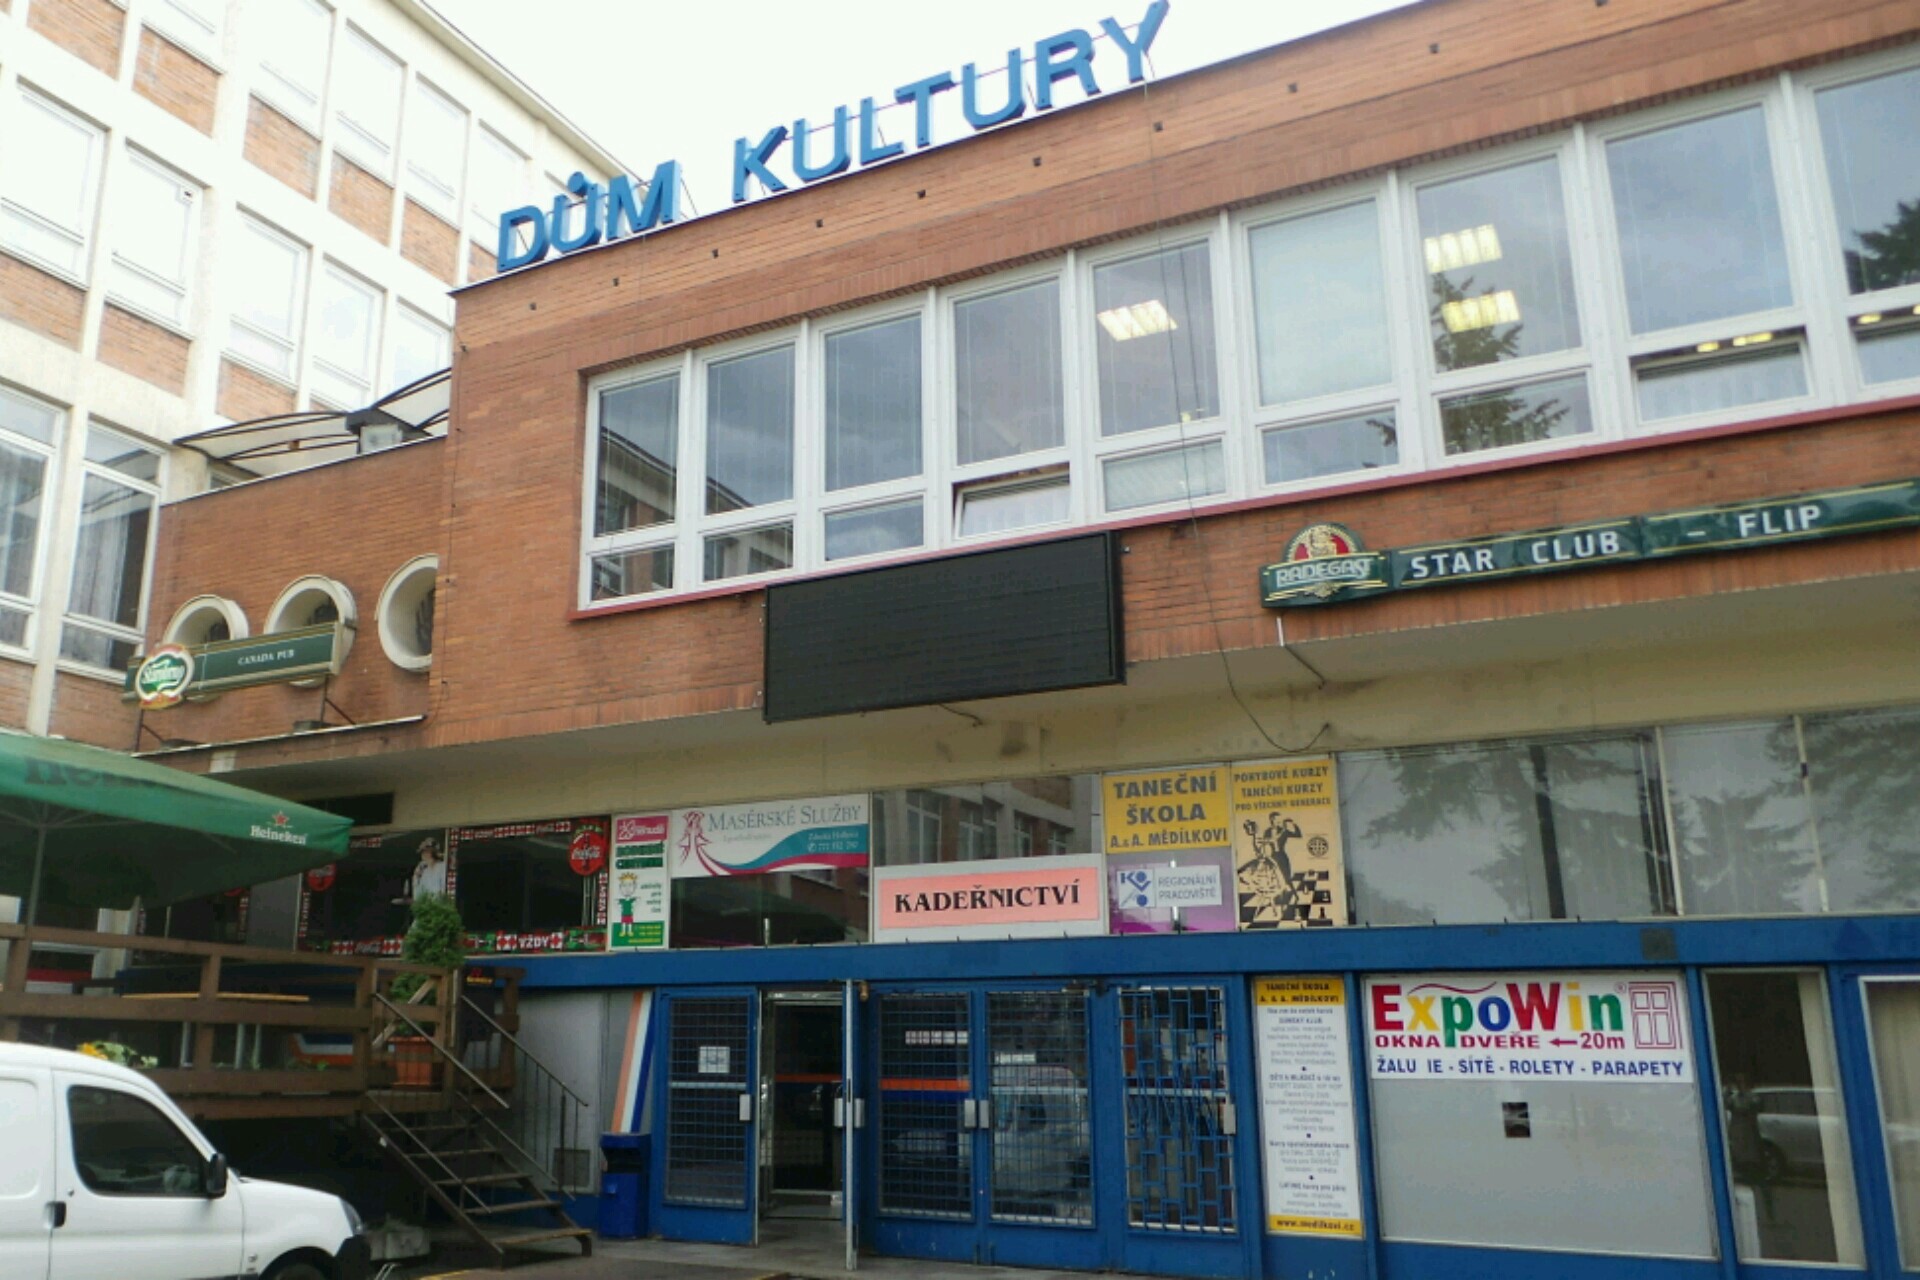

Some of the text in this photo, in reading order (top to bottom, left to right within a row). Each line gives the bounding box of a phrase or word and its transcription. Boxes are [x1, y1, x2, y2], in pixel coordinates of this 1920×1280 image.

[497, 0, 1169, 272] DŮM KULTURY
[1411, 548, 1494, 579] STAR
[1531, 531, 1620, 565] CLUB
[1739, 505, 1821, 540] FLIP
[1276, 558, 1374, 588] RADEGAST
[237, 648, 295, 666] CANADA PUB
[1113, 770, 1216, 799] TANEČNÍ
[1234, 766, 1328, 782] POHYBOVÉ KURZY
[1242, 783, 1323, 797] TANEČNÍ KURZY
[708, 803, 861, 832] MASÉRSKÉ SLUŽBY
[1126, 803, 1206, 825] ŠKOLA
[1235, 803, 1251, 811] PRO
[250, 825, 308, 845] Heineken
[1158, 872, 1217, 887] REGIONÁLNÍ
[894, 878, 1081, 913] KADEŘNICTVÍ
[1158, 887, 1217, 900] PRACOVIŠTĚ
[518, 934, 550, 949] VŽDY
[1371, 981, 1625, 1048] ExpoWin
[1375, 1031, 1625, 1050] OKNA DVEŘE 20m
[1458, 1055, 1495, 1074] SÍTĚ
[1509, 1059, 1575, 1075] ROLETY
[1592, 1060, 1684, 1077] PARAPETY
